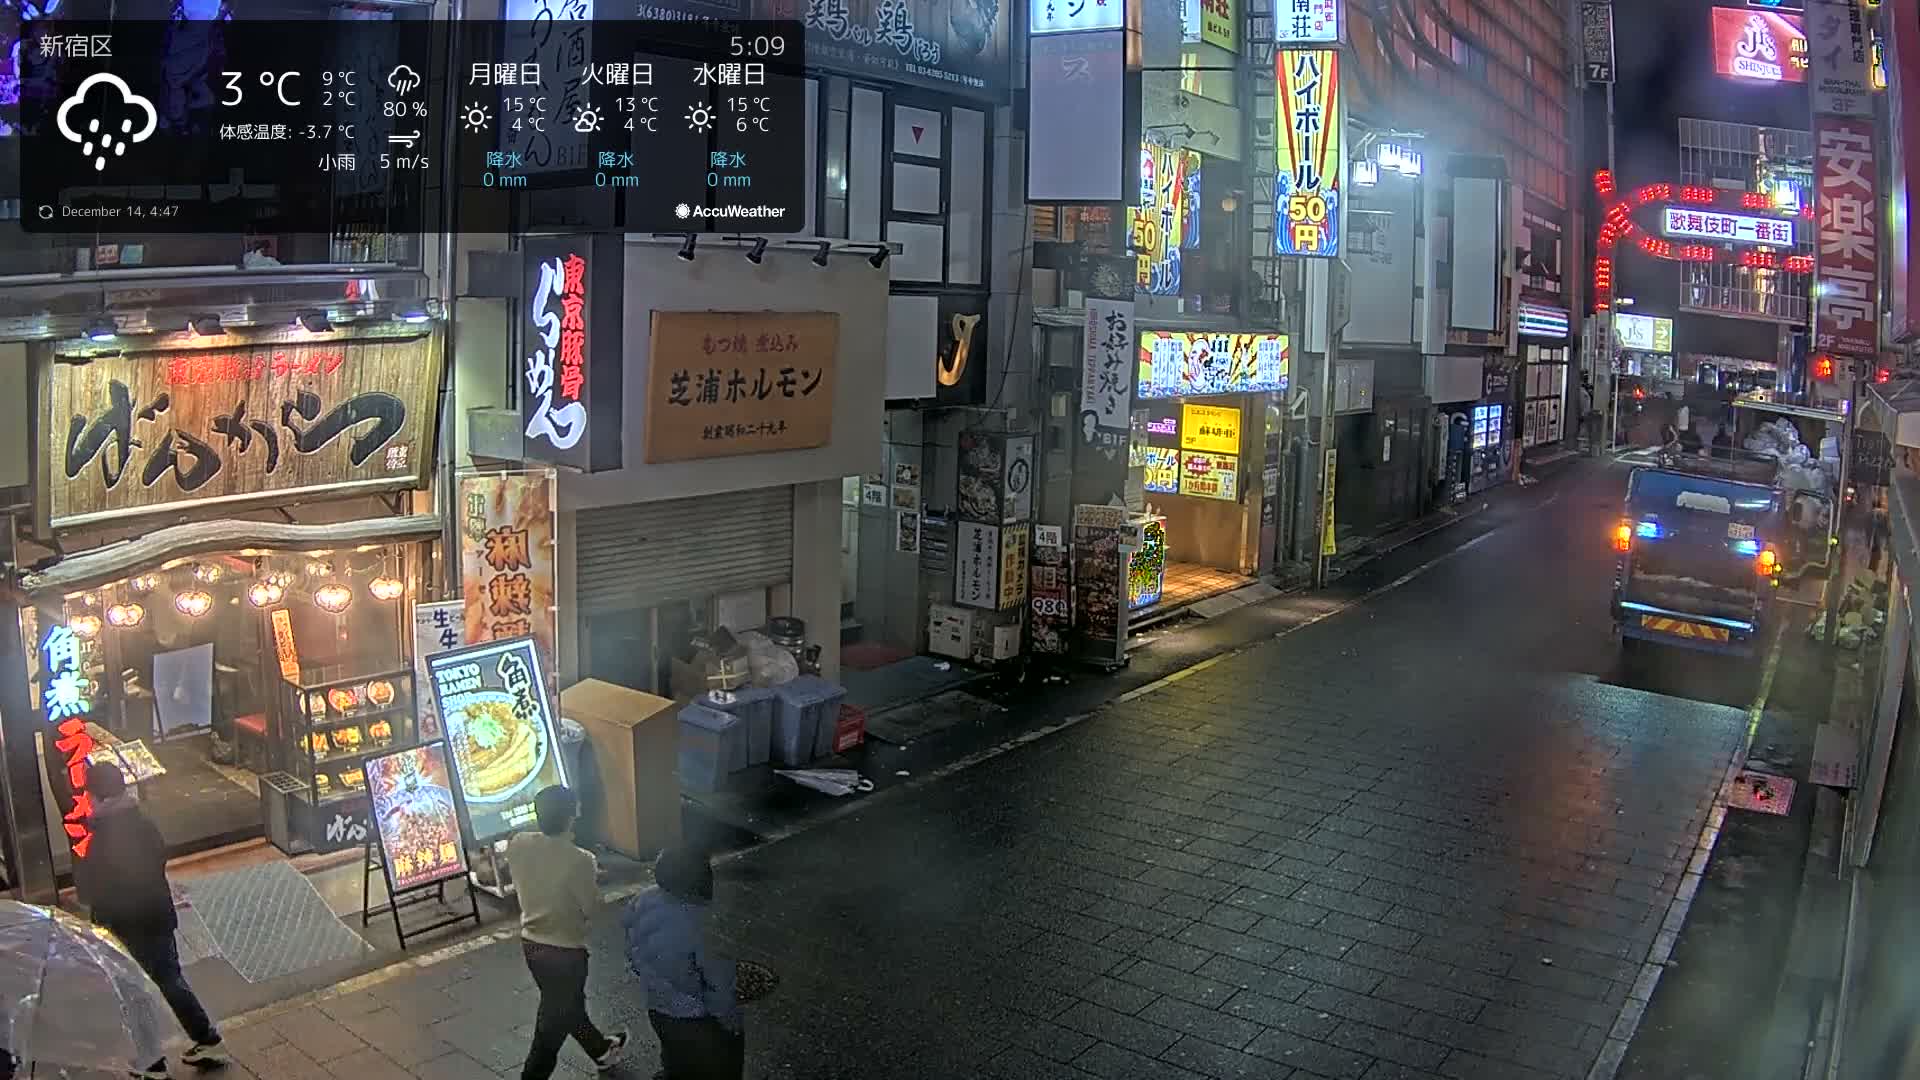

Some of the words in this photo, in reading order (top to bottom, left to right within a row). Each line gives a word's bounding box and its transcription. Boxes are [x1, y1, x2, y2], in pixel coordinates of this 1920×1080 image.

[1589, 64, 1608, 78] 7F
[1295, 53, 1322, 191] ハイボール
[1159, 152, 1174, 290] ハイボール
[1289, 196, 1327, 251] 50円
[1669, 211, 1789, 242] 歌舞伎町一番街
[1820, 127, 1876, 331] 安楽亭
[560, 253, 586, 401] 東京豚骨
[1817, 334, 1836, 347] 2F
[1100, 309, 1129, 415] お好み焼き
[668, 367, 823, 406] 芝浦ホルモン
[64, 379, 406, 493] ばんから
[702, 418, 788, 440] 創業昭和二十九年
[970, 527, 983, 601] 芝浦ホルモン
[435, 662, 480, 684] TOKYO
[439, 675, 482, 697] RAMEN
[501, 654, 537, 721] 角煮
[441, 691, 473, 709] SHOP
[326, 813, 368, 844] ばん
